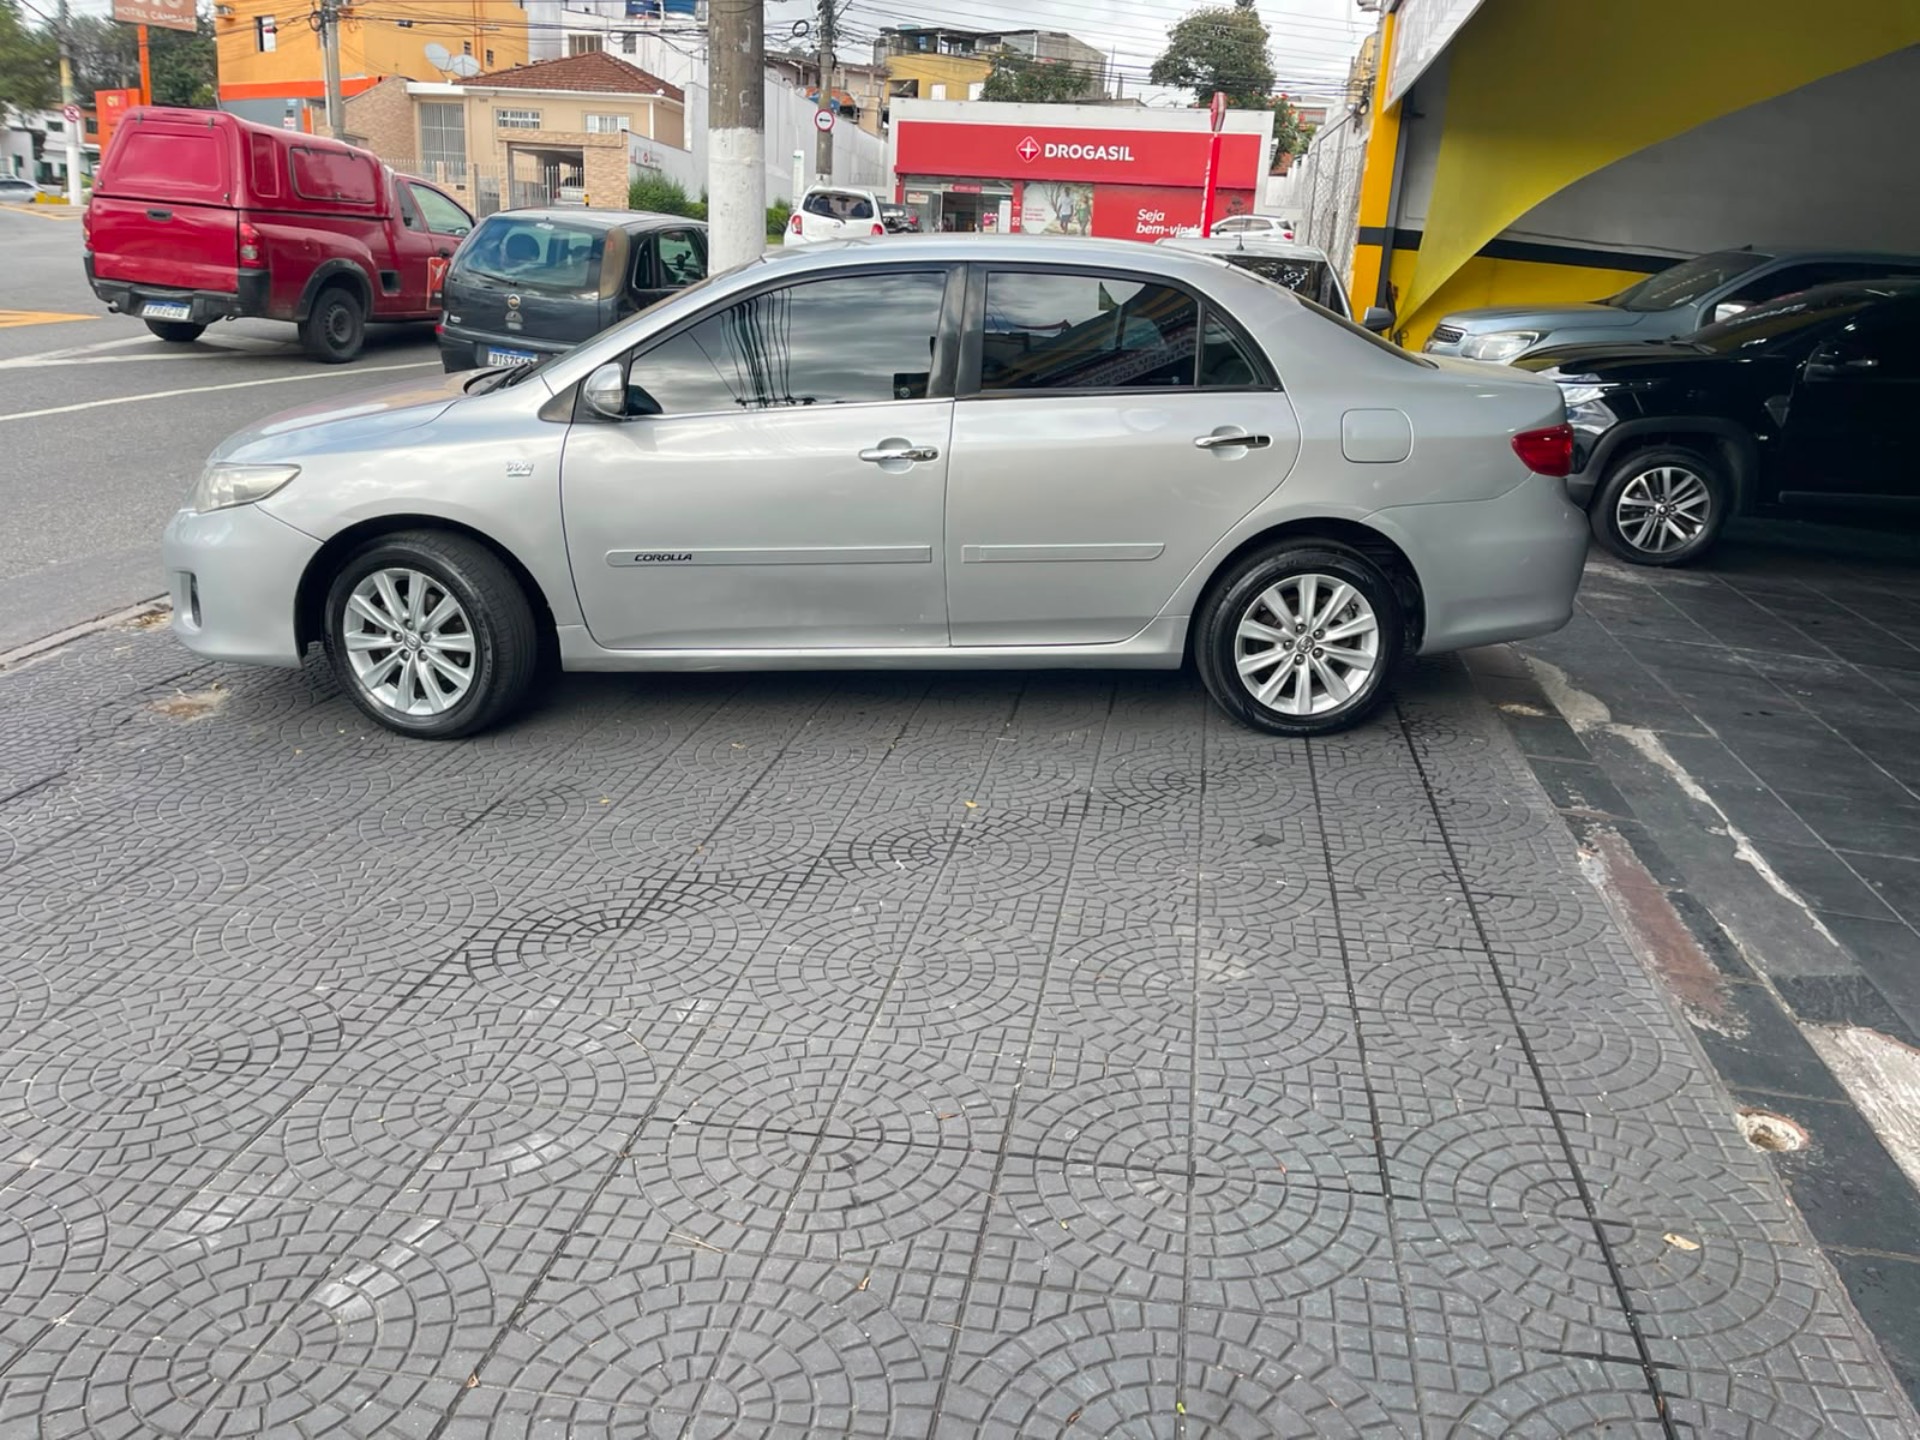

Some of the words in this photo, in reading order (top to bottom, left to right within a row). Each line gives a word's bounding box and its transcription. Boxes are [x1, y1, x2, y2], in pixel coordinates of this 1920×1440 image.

[1044, 143, 1135, 161] DROGASIL
[1137, 208, 1165, 223] Seja
[634, 553, 692, 562] COROLLA
